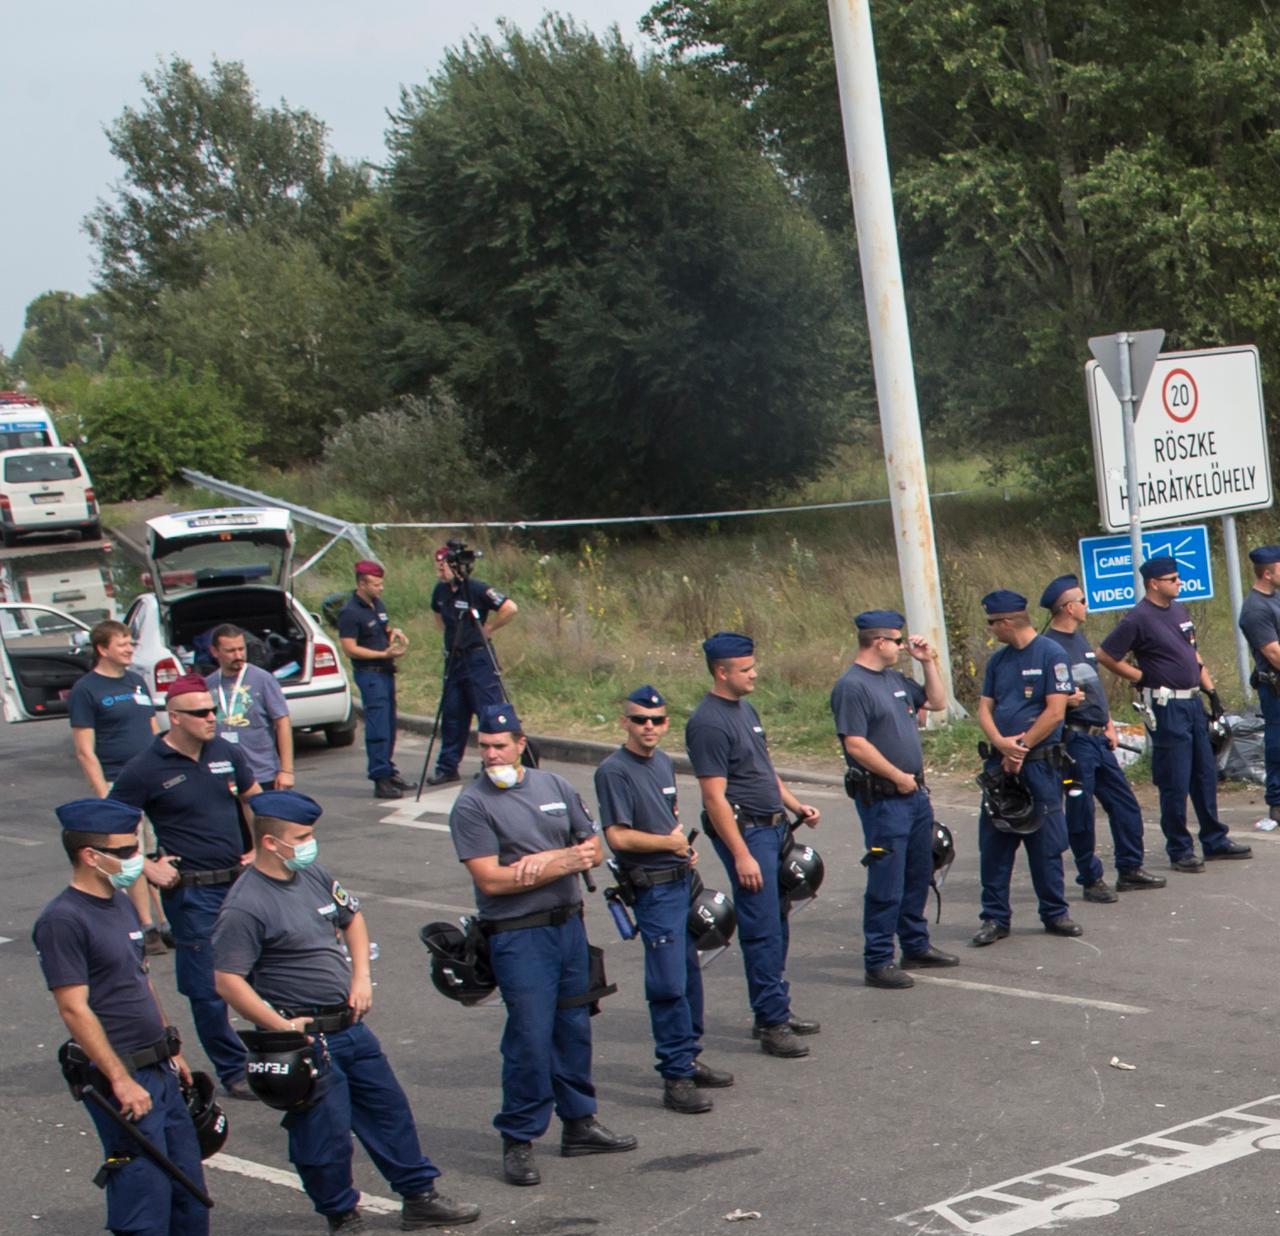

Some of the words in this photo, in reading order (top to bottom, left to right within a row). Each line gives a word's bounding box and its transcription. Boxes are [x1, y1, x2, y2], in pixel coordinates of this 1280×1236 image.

[1171, 384, 1189, 406] 20
[1154, 430, 1217, 463] RÖSZKE
[1119, 461, 1256, 510] HTÁRÁTKELŐHELY
[1100, 554, 1146, 568] CAME
[1092, 586, 1134, 603] VIDEO
